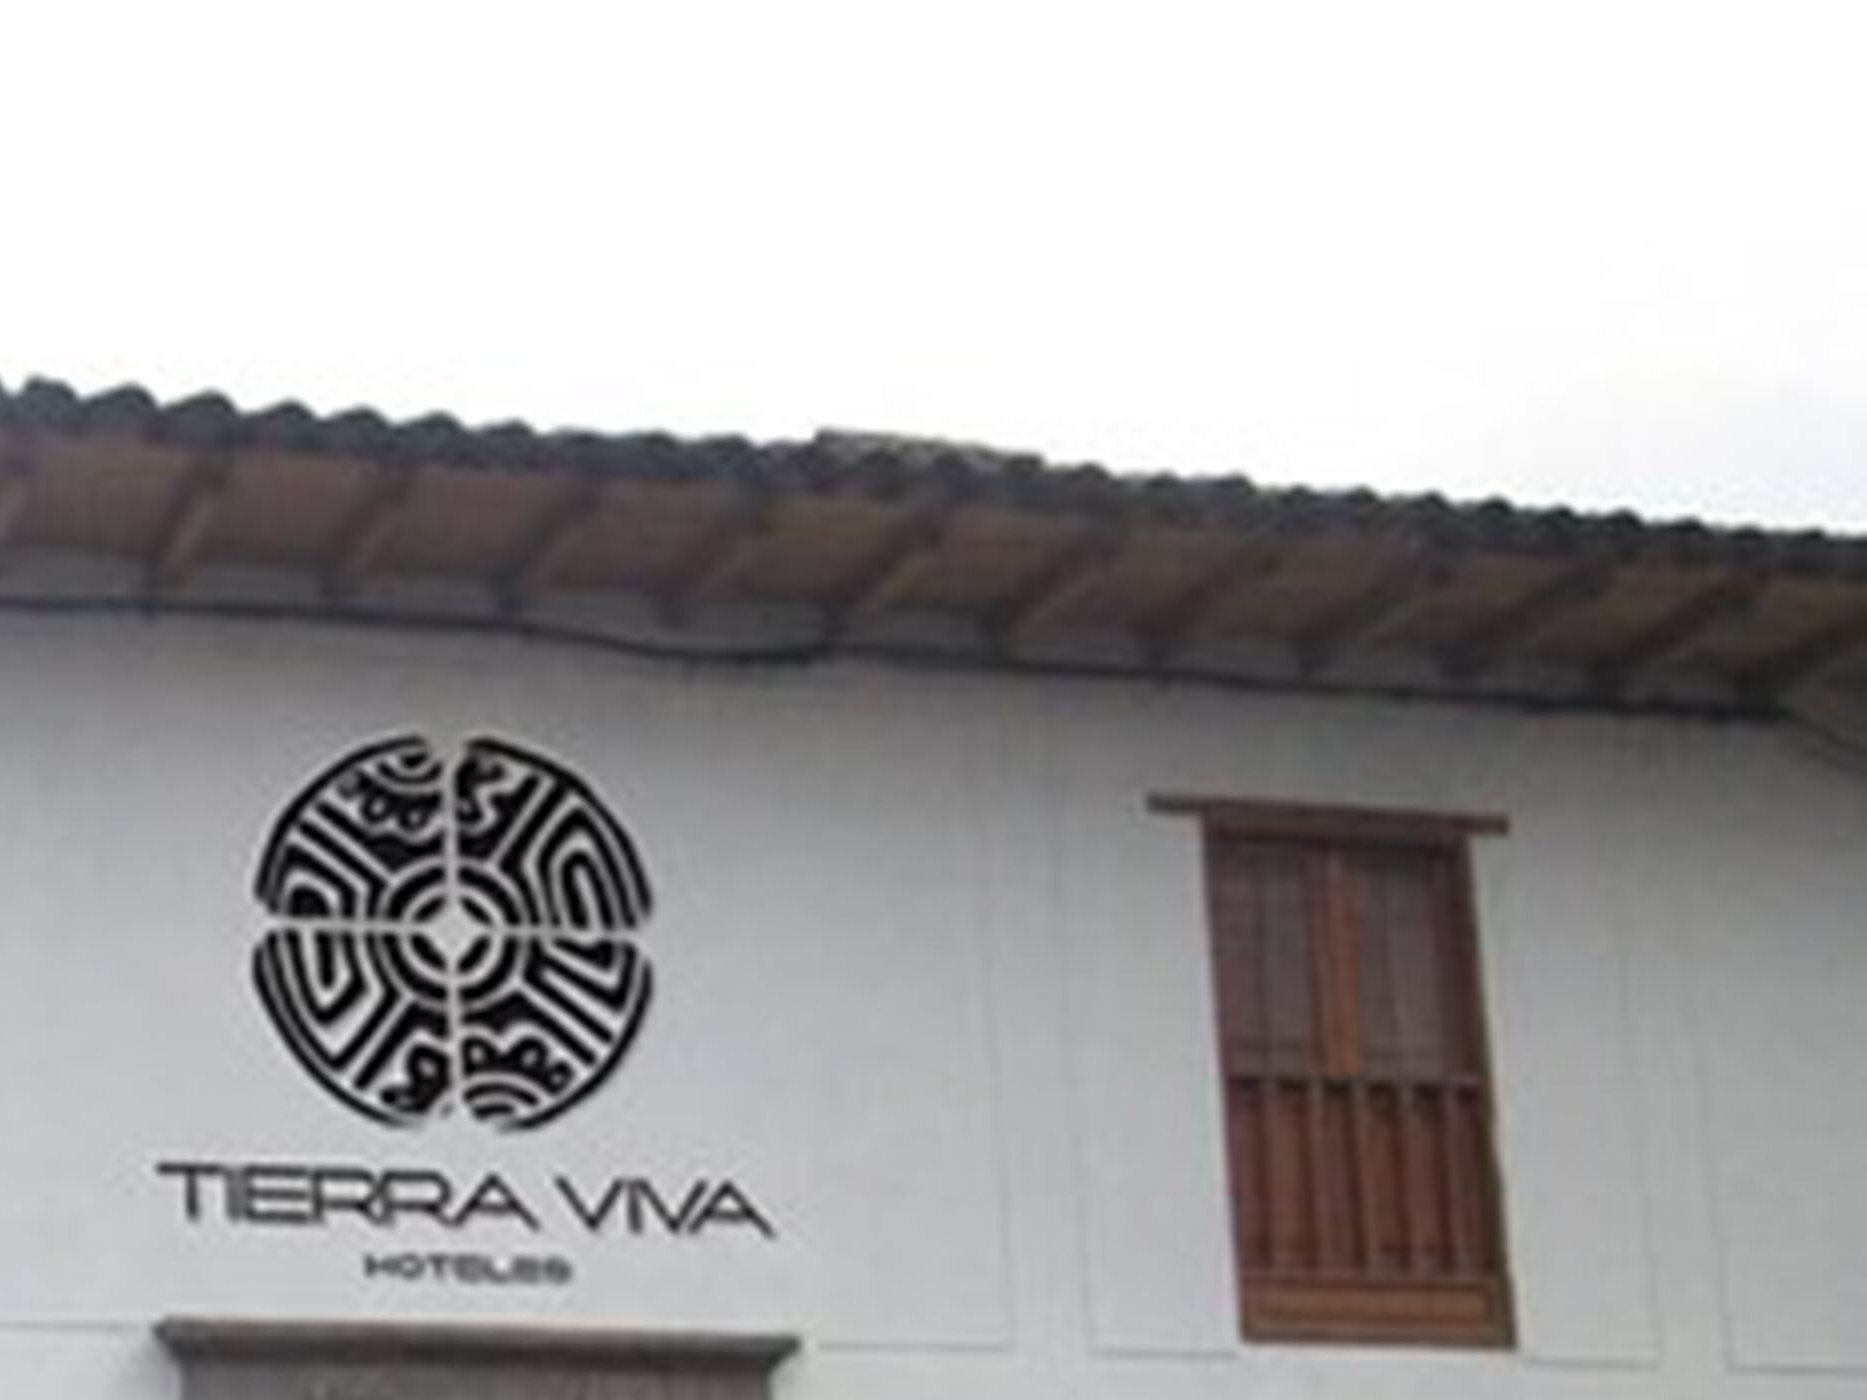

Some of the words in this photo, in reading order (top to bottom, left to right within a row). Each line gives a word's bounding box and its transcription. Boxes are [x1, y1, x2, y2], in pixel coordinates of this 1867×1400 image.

[156, 1160, 540, 1231] TIERRA
[554, 1175, 775, 1238] VIVA
[363, 1252, 573, 1284] HOTELES
